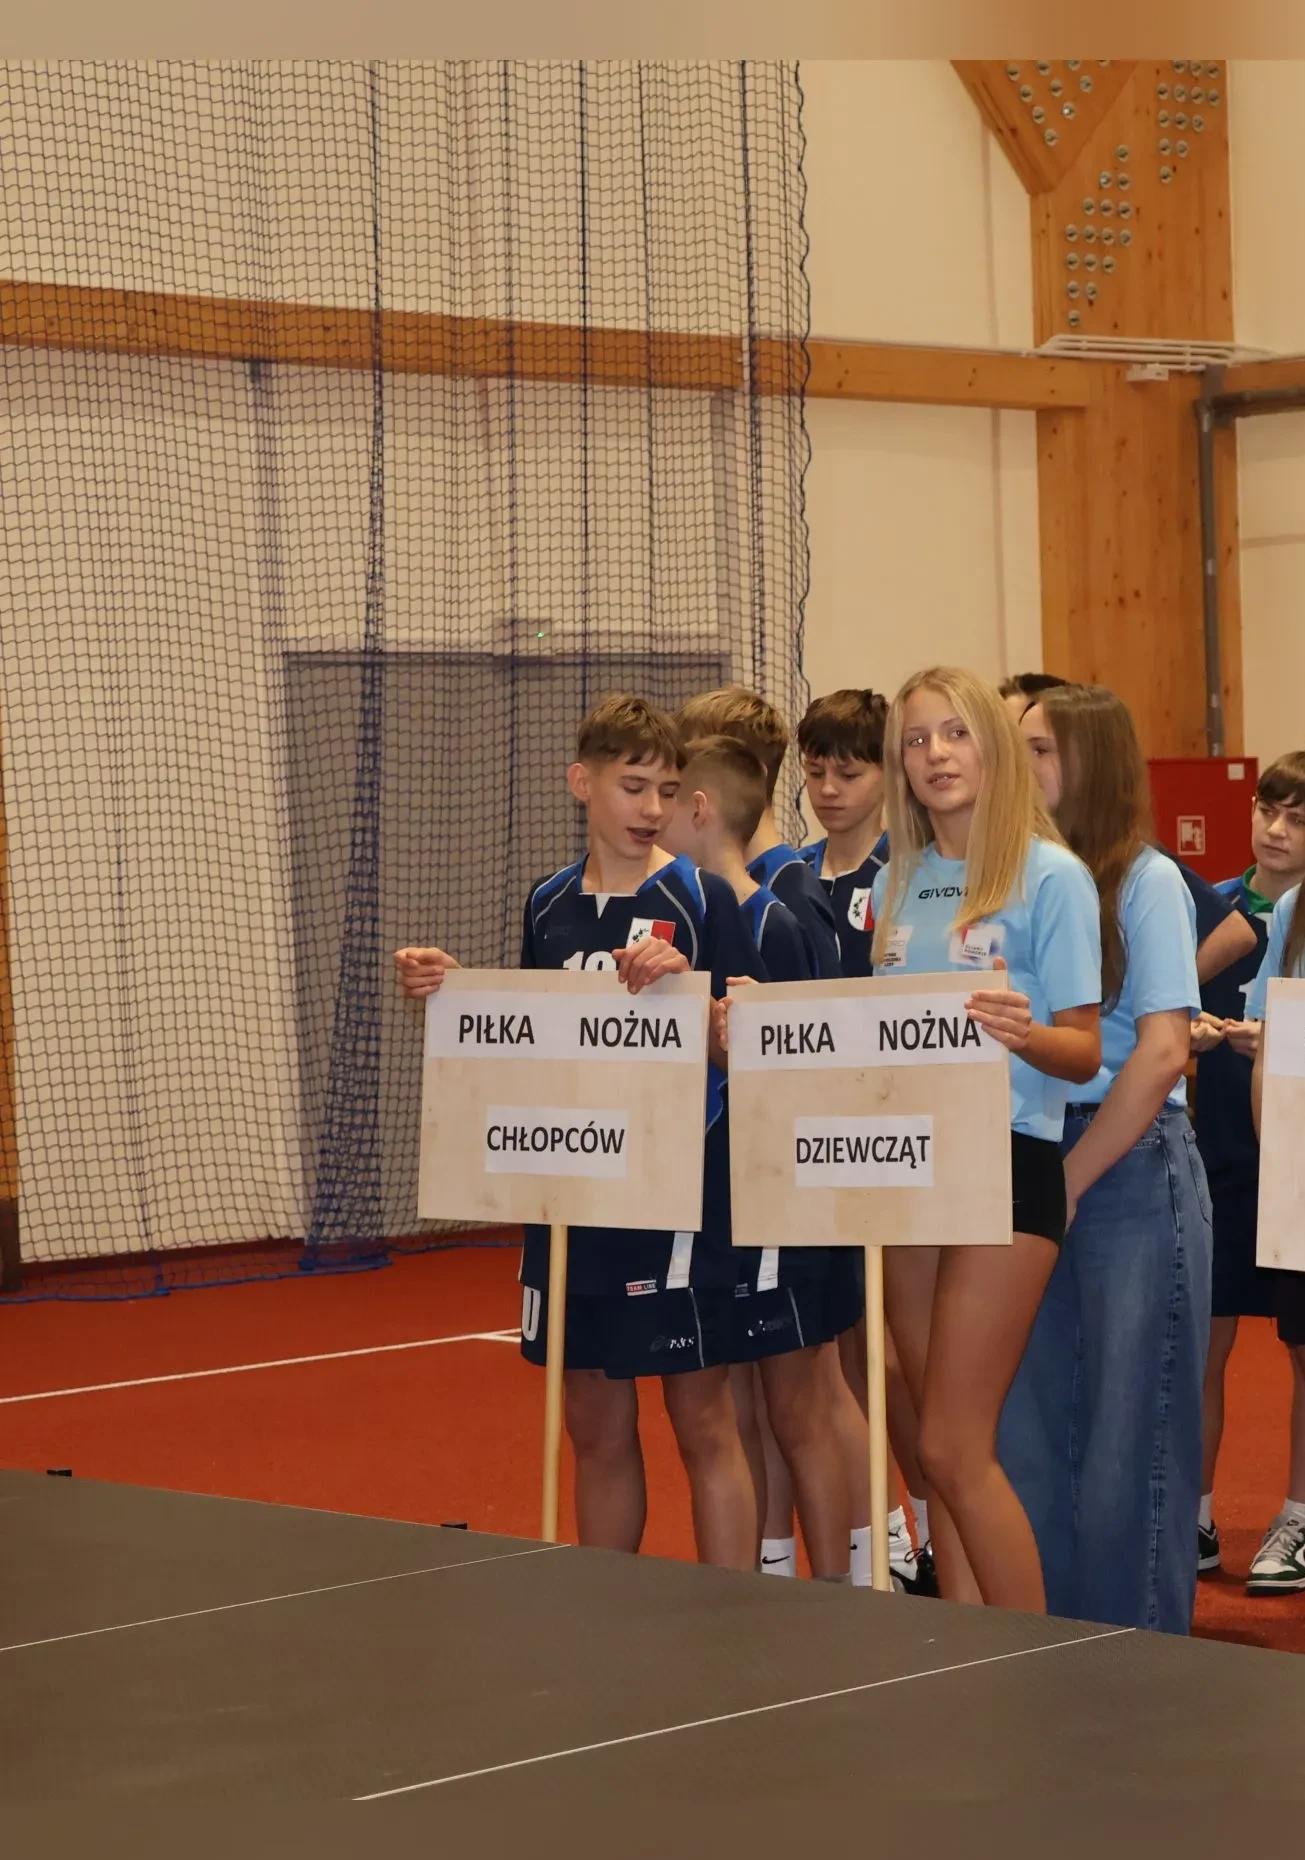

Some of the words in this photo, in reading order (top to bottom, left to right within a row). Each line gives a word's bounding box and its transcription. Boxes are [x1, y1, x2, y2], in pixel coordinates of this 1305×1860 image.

[918, 886, 968, 899] GIVOV
[458, 1014, 535, 1045] PIŁKA
[579, 1009, 682, 1049] NOŻNA
[761, 1022, 836, 1056] PIŁKA
[879, 1009, 982, 1052] NOŻNA
[486, 1120, 625, 1154] CHŁOPCÓW
[796, 1135, 931, 1170] DZIEWCZĄT
